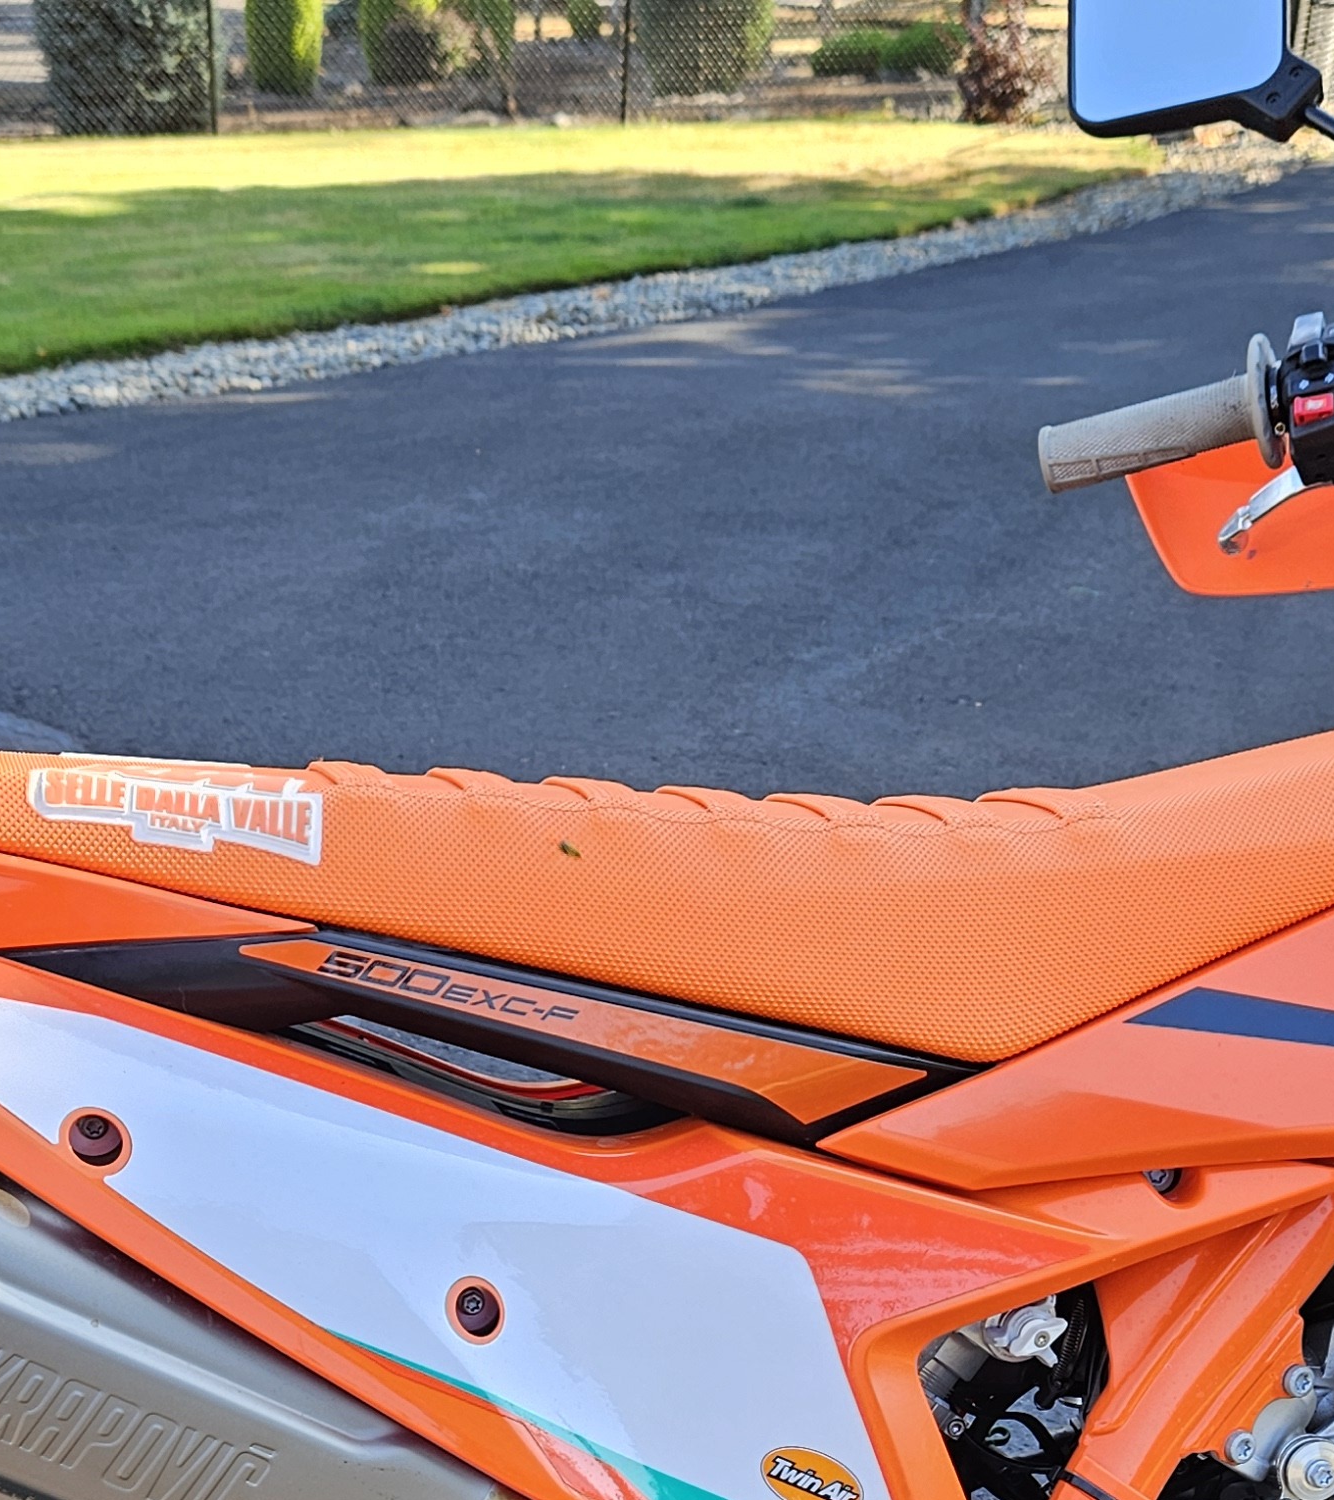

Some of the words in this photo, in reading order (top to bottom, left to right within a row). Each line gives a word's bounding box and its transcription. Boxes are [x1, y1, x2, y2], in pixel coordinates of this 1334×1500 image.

[134, 784, 222, 823] DALLA
[230, 796, 313, 847] VALLE
[150, 813, 205, 833] ITALY
[768, 1456, 822, 1492] Twin
